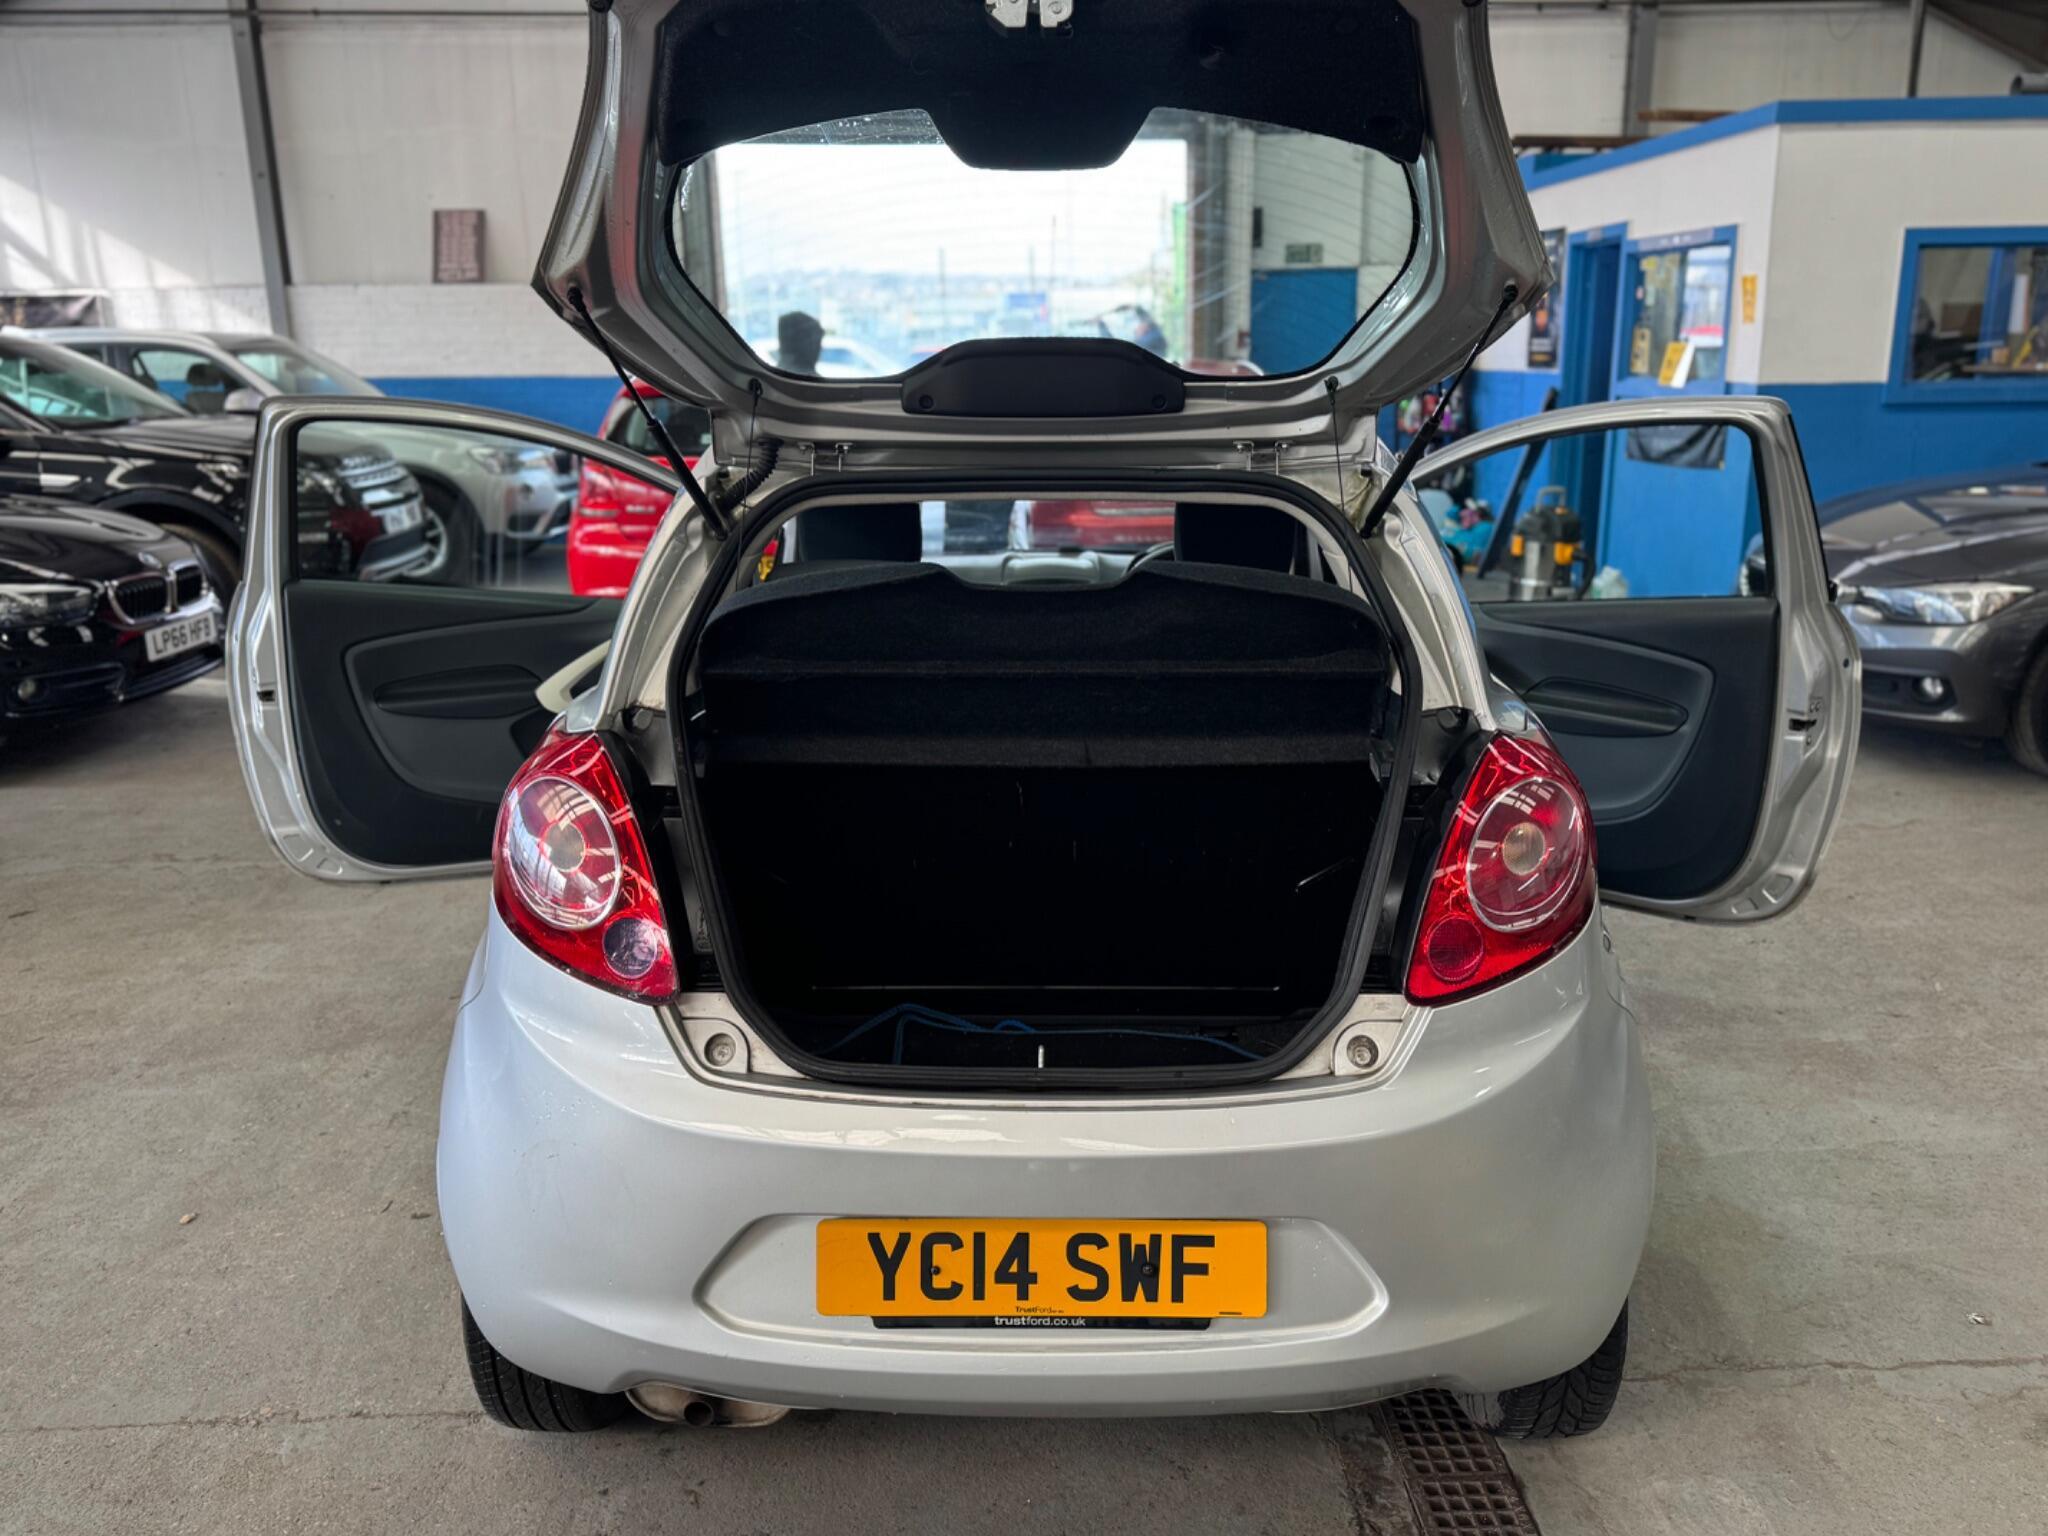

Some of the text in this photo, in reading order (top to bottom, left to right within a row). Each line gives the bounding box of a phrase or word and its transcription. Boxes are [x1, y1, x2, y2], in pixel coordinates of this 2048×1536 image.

[867, 1231, 1216, 1303] YC14 SWF
[994, 1316, 1086, 1326] trustford.co.uk
